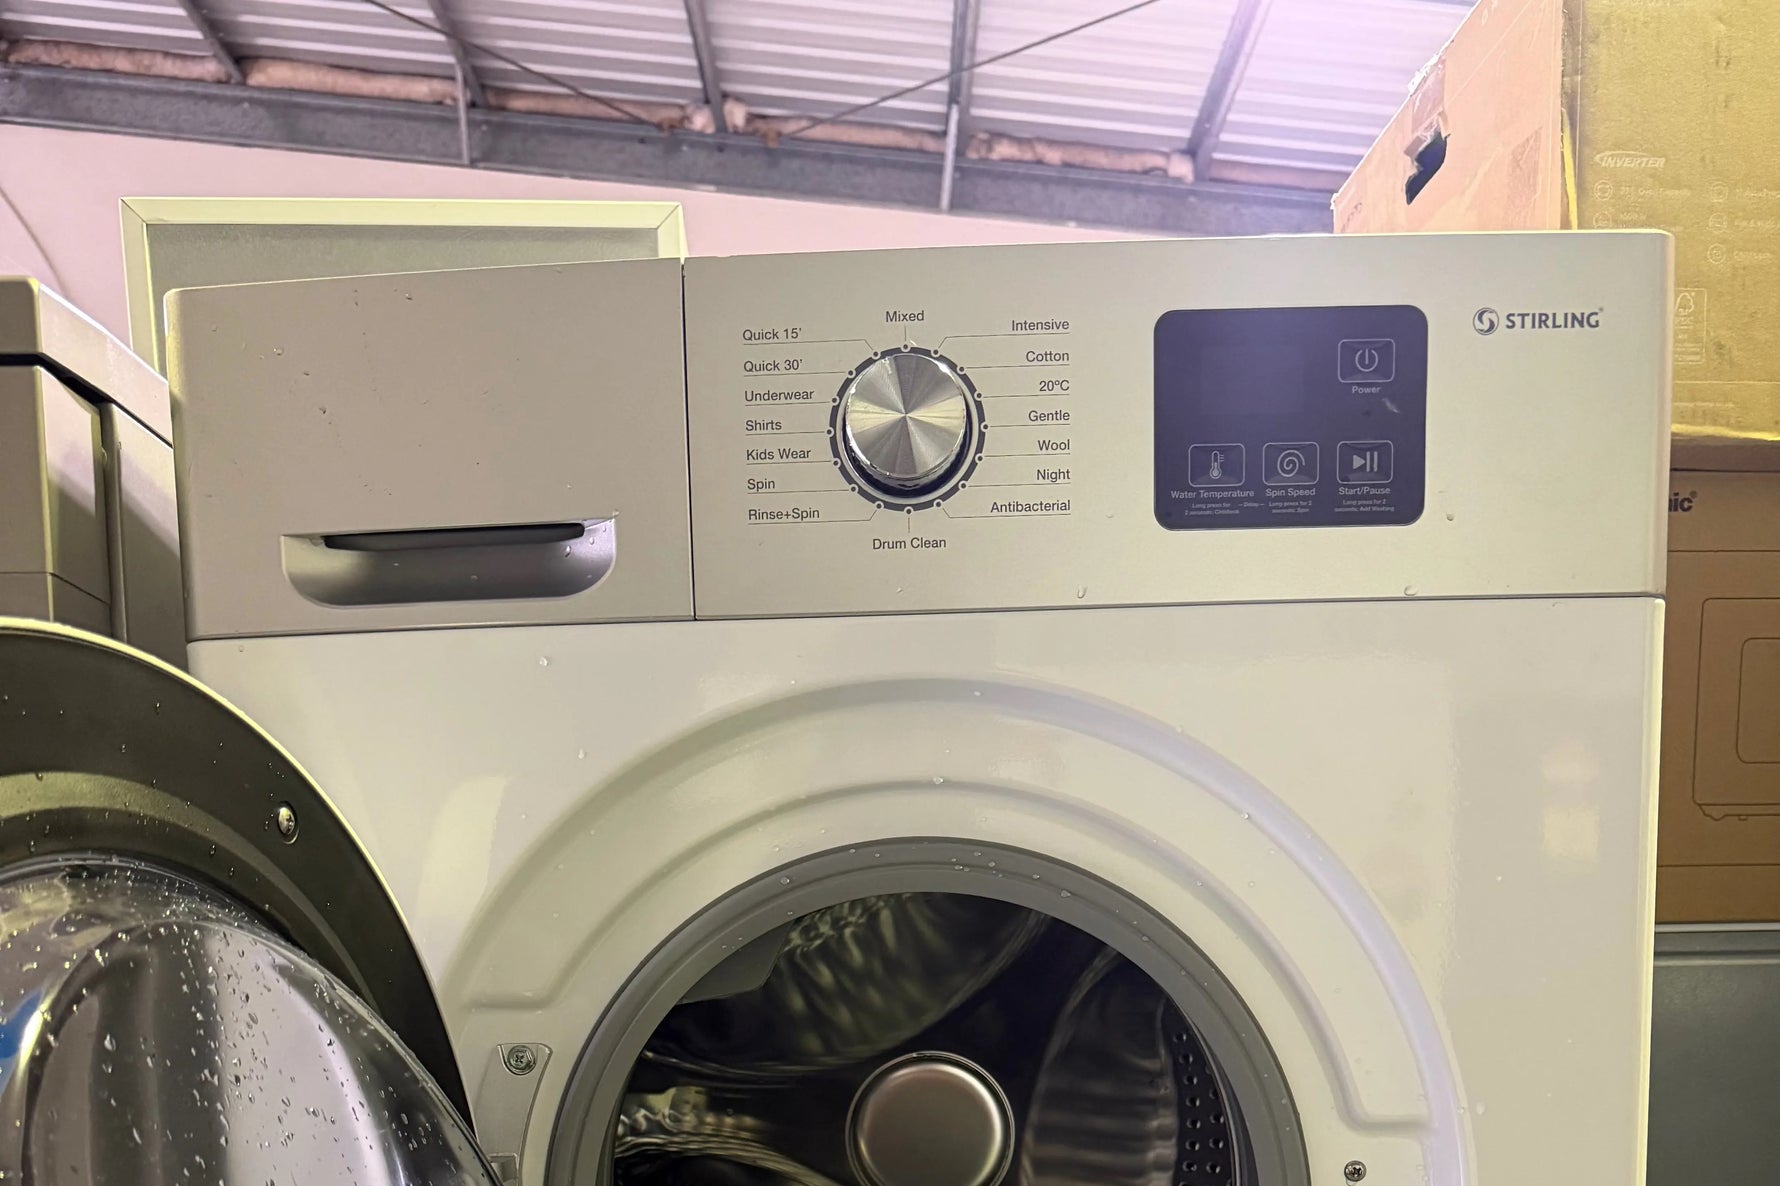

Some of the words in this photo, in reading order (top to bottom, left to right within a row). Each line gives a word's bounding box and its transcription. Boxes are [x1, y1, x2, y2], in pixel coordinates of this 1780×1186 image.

[1601, 157, 1665, 168] INVERTER
[885, 310, 925, 322] Mixed
[1505, 311, 1600, 330] STIRLING
[1011, 319, 1070, 331] Intensive
[742, 329, 780, 341] Quick
[782, 327, 802, 339] 15'
[1025, 350, 1070, 363] Cotton
[743, 360, 781, 373] Quick
[783, 359, 803, 370] 30'
[744, 389, 814, 402] Underwear
[1352, 386, 1380, 394] Power
[1028, 410, 1070, 422] Gentle
[745, 420, 782, 431] Shirts
[1038, 440, 1070, 451] Wool
[746, 449, 775, 461] Kids
[777, 448, 811, 460] Wear
[1036, 469, 1071, 483] Night
[747, 479, 776, 492] Spin
[1338, 486, 1391, 495] Start/Pause
[1170, 490, 1197, 499] Water
[1198, 489, 1255, 499] Temperature
[1265, 488, 1285, 498] Spin
[1287, 488, 1316, 497] Speed
[990, 500, 1071, 513] Antibacterial
[748, 508, 820, 522] Rinse+Spin
[872, 538, 907, 550] Drum
[910, 537, 947, 549] Clean
